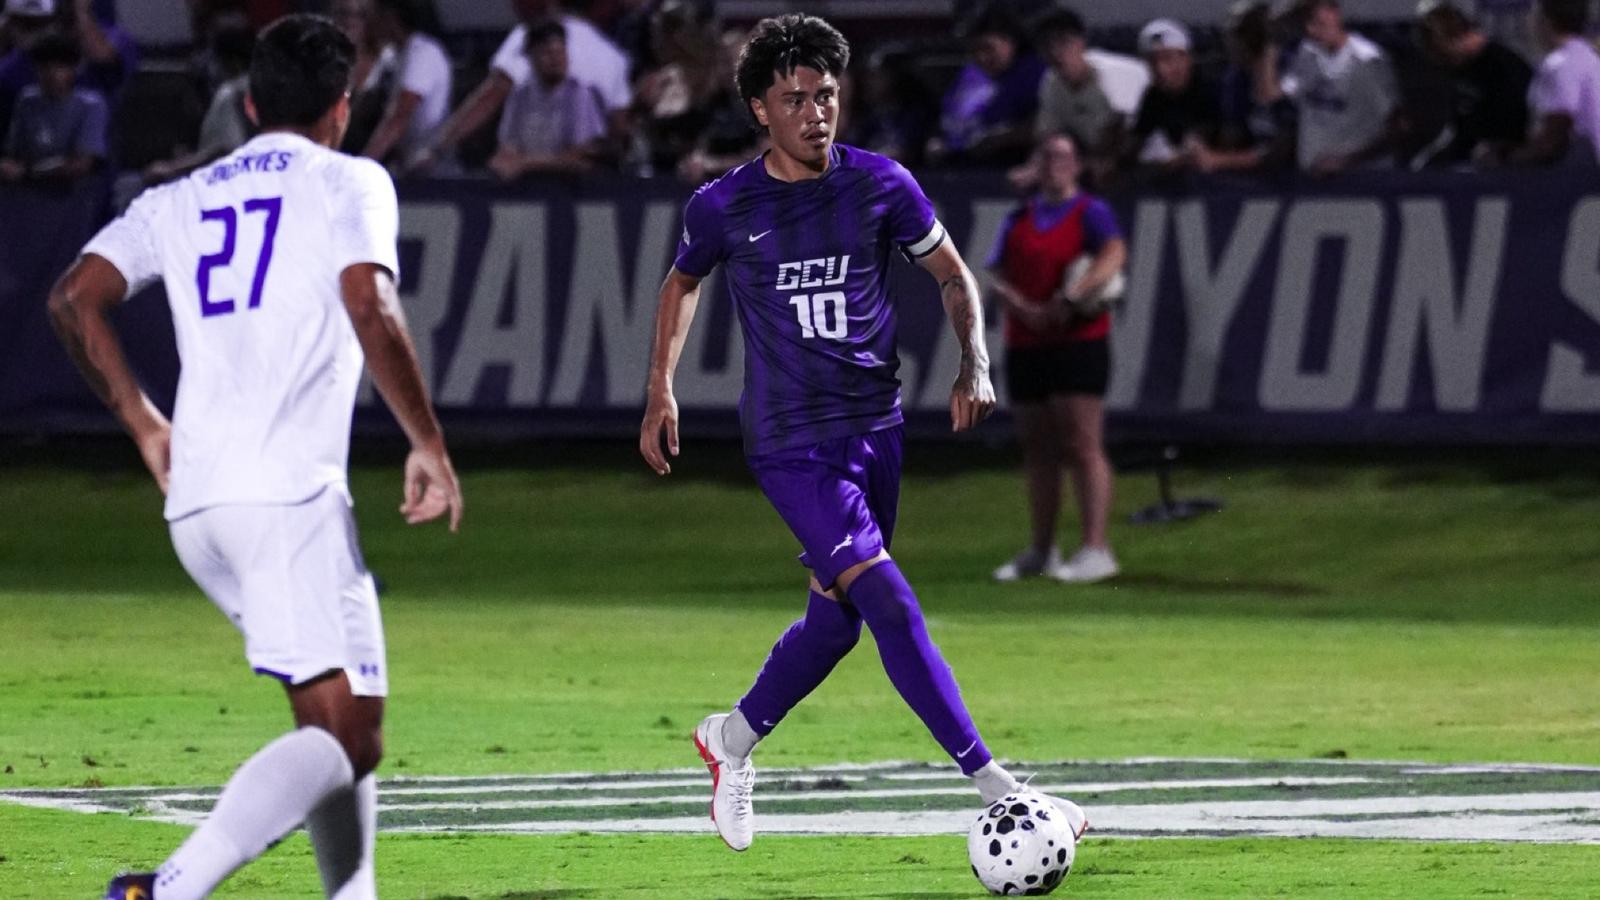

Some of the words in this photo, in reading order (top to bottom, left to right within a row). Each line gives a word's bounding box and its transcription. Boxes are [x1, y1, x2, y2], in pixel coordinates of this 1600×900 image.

[196, 197, 282, 317] 27
[776, 254, 850, 290] GCU
[789, 291, 848, 338] 10
